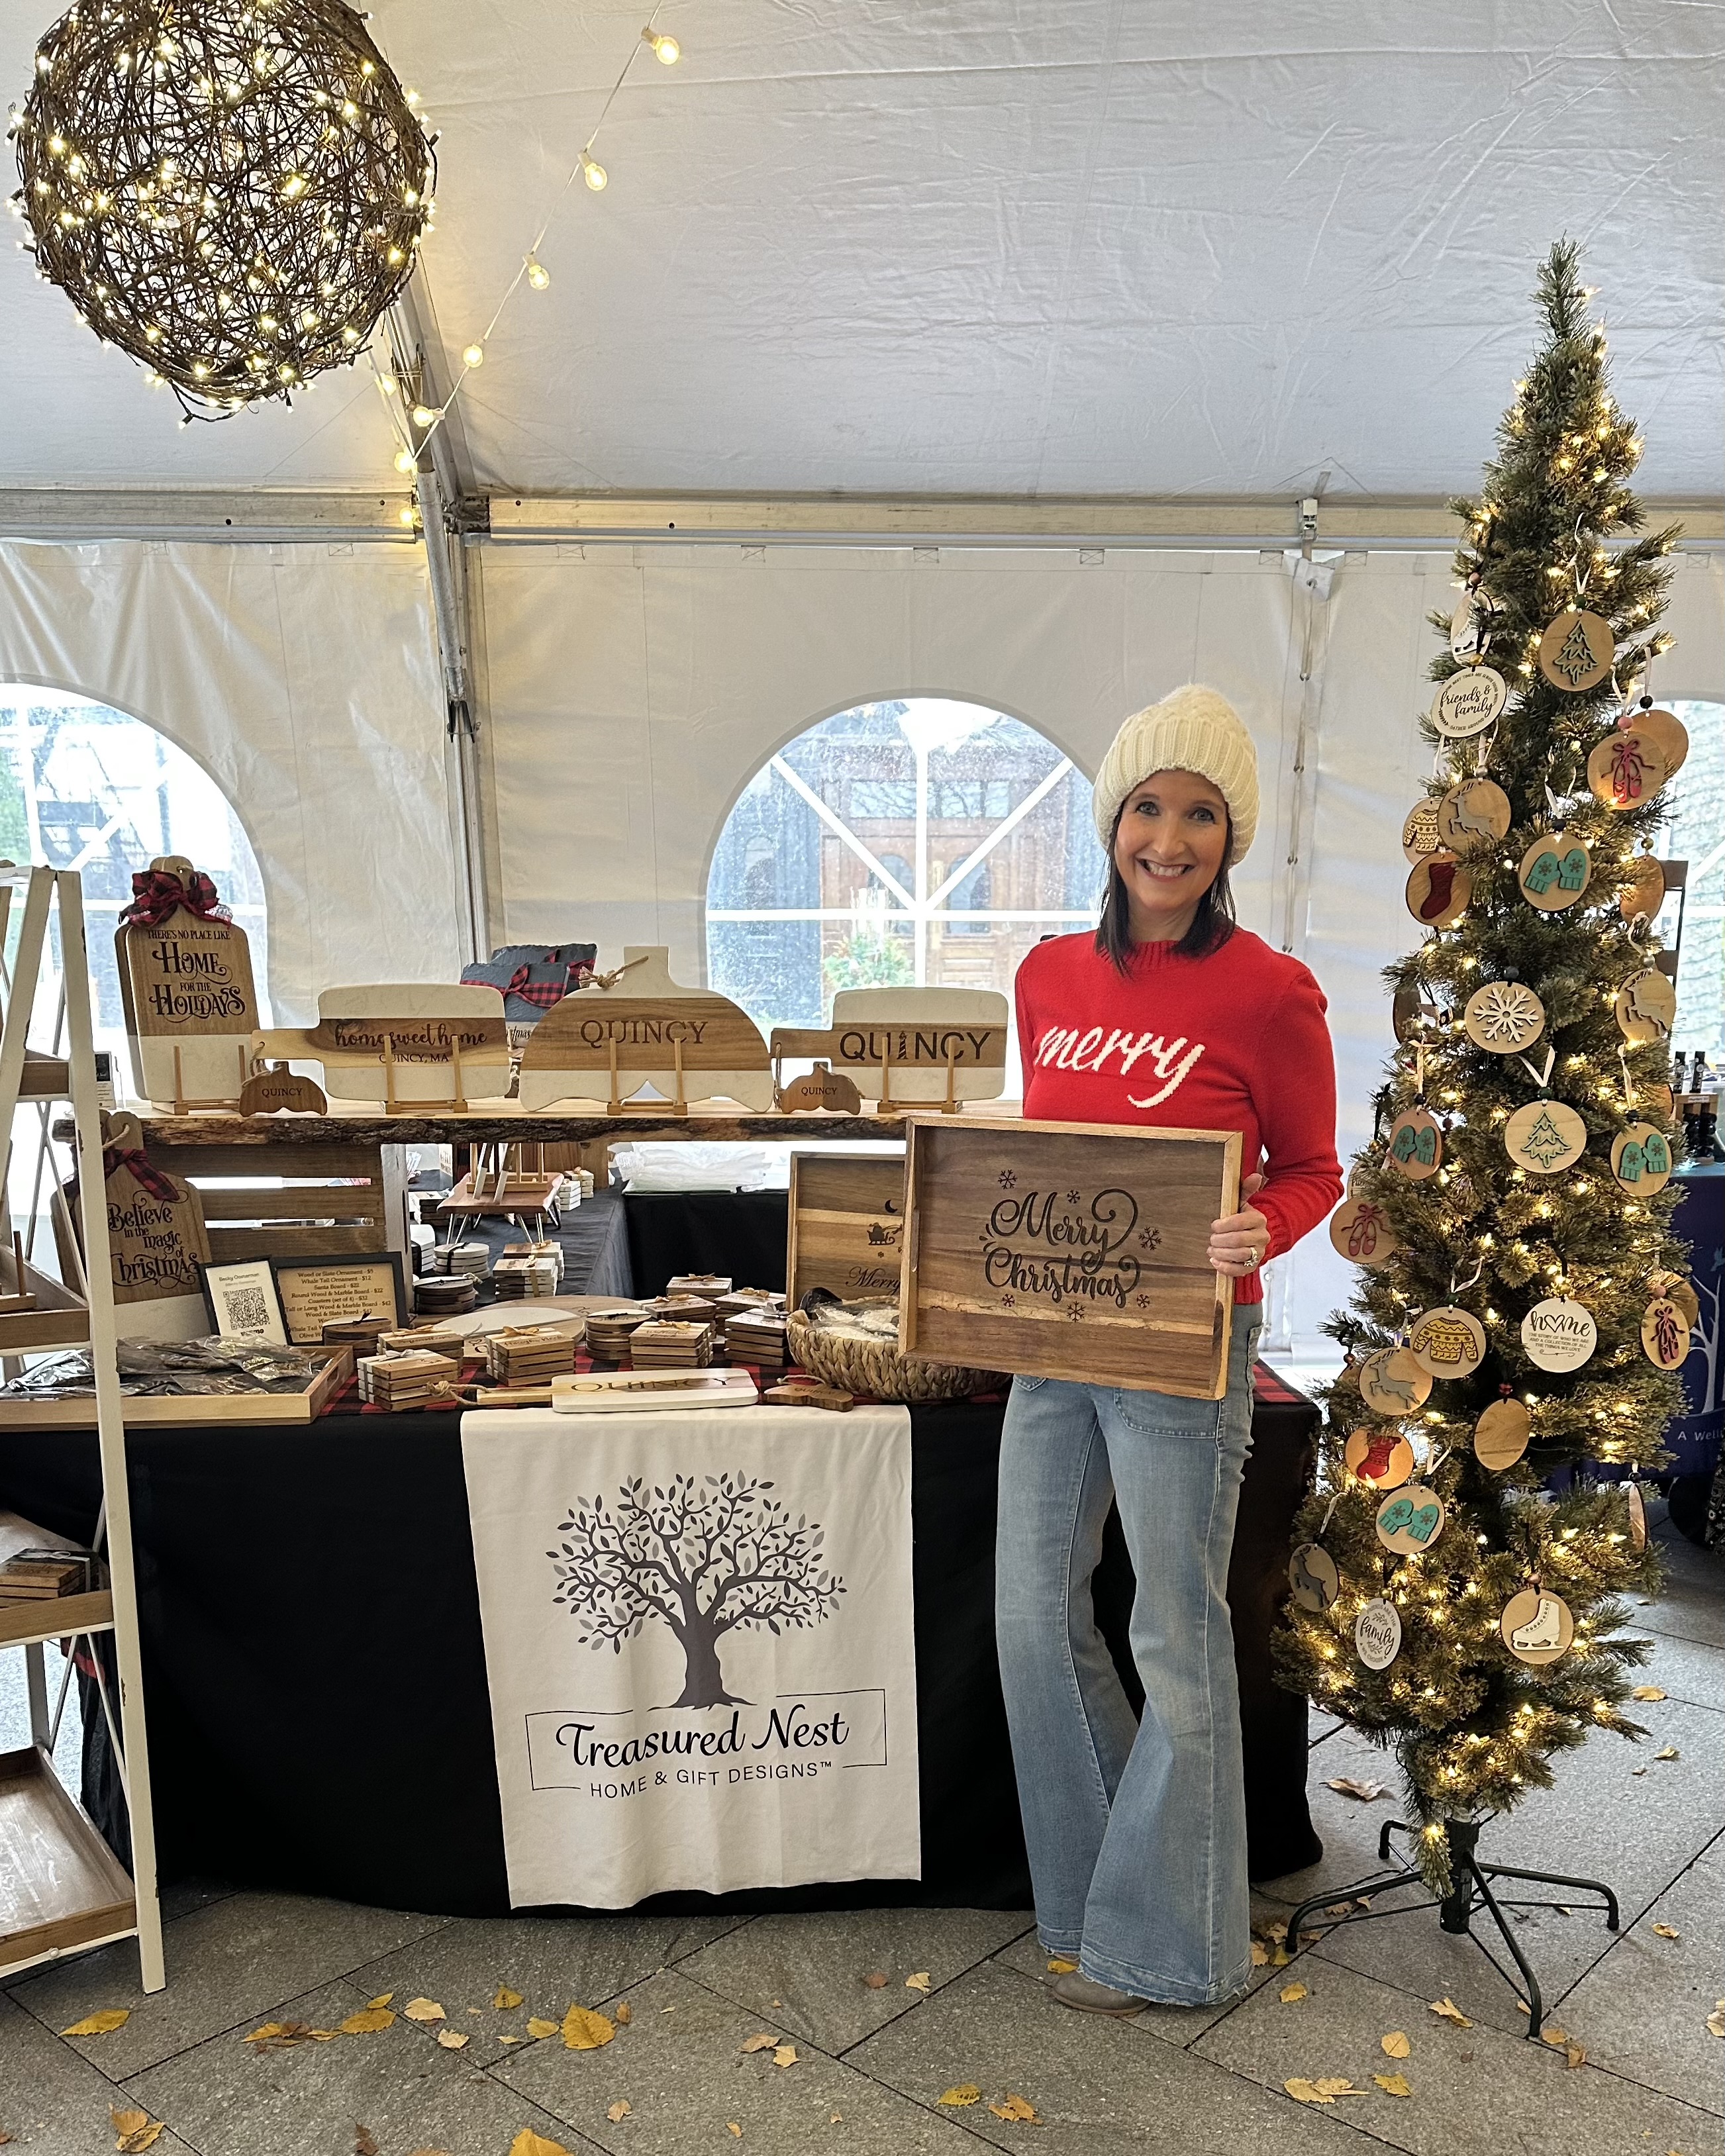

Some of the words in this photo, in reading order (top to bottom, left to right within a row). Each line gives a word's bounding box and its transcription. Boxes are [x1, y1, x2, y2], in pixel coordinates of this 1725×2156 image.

[1440, 686, 1483, 708] friends
[1484, 684, 1492, 695] &
[1454, 697, 1493, 719] family
[147, 929, 177, 940] THERE'S
[177, 930, 189, 940] NO
[191, 930, 212, 940] PLACE
[213, 930, 231, 940] LIKE
[179, 982, 194, 992] FOR
[195, 982, 212, 992] THE
[334, 1023, 384, 1047] home
[388, 1022, 436, 1050] sweet
[580, 1020, 709, 1049] QUINCY
[430, 1054, 450, 1063] MA
[1034, 1026, 1206, 1108] merry
[262, 1087, 303, 1097] QUINCY
[801, 1087, 838, 1096] QUINCY
[134, 1224, 149, 1236] the
[991, 1188, 1139, 1275] Merry
[142, 1230, 183, 1254] magic
[175, 1246, 185, 1258] of
[985, 1246, 1141, 1308] Christmas
[571, 1377, 731, 1393] QUINCY
[1677, 1431, 1687, 1441] A
[1359, 1616, 1395, 1655] family
[556, 1710, 747, 1768] Treasured
[752, 1704, 850, 1750] Nest
[590, 1775, 648, 1799] HOME
[654, 1771, 667, 1786] &
[676, 1771, 721, 1787] GIFT
